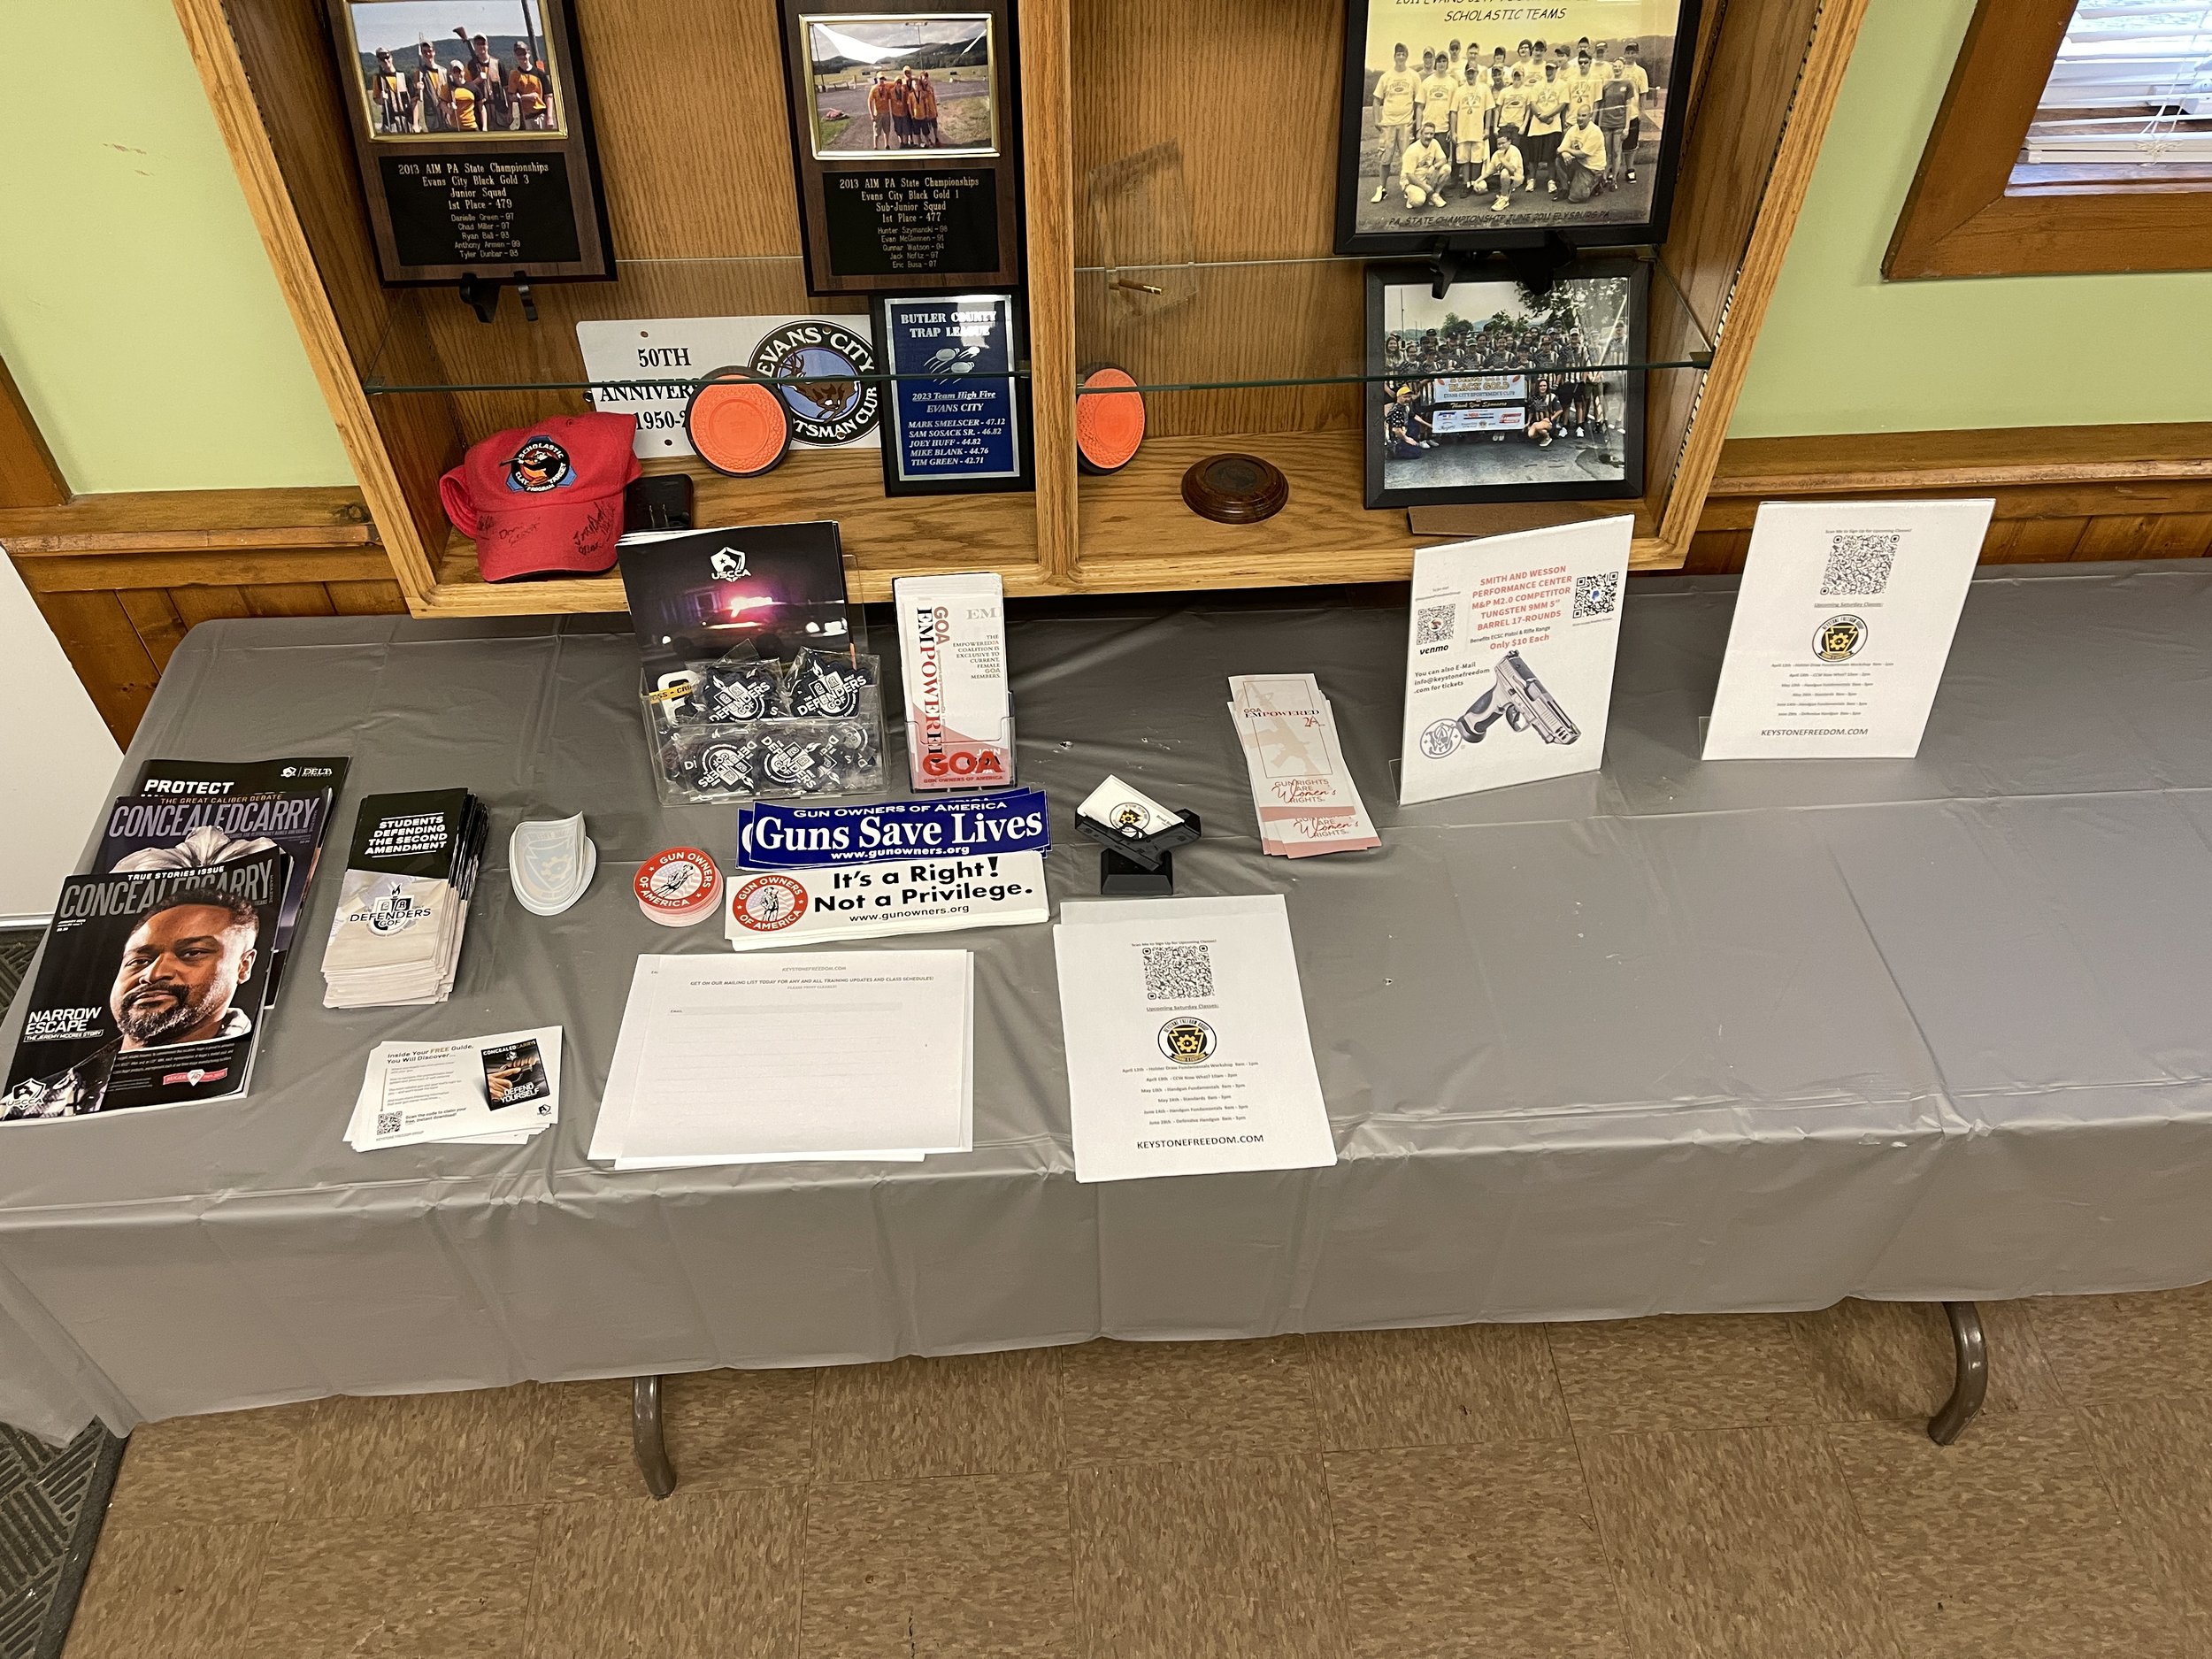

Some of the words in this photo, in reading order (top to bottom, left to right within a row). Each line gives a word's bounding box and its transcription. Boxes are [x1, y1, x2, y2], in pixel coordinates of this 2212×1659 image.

[1444, 10, 1522, 22] SCHOLASTIC
[1526, 8, 1567, 19] TEAMS
[399, 165, 419, 174] 2013
[426, 164, 441, 173] AIM
[447, 164, 458, 173] PA
[465, 163, 484, 173] State
[490, 162, 549, 174] Championships
[423, 177, 446, 187] Evans
[452, 176, 467, 187] City
[473, 175, 495, 185] Black
[501, 175, 518, 184] Gold
[524, 175, 529, 184] 3
[840, 180, 859, 188] 2013
[865, 179, 879, 188] AIM
[885, 179, 895, 188] PA
[902, 178, 919, 188] State
[925, 177, 979, 188] Championships
[450, 188, 476, 197] Junior
[482, 188, 506, 198] Squad
[862, 191, 883, 201] Evans
[888, 191, 903, 202] City
[909, 190, 928, 199] Black
[933, 189, 949, 199] Gold
[449, 201, 459, 210] 1st
[465, 200, 486, 209] Place
[495, 199, 512, 208] 479
[876, 202, 918, 211] Sub-Junior
[924, 202, 946, 211] Squad
[883, 214, 892, 223] 1st
[898, 213, 917, 222] Place
[926, 212, 941, 221] 477
[901, 313, 946, 324] BUTLER
[910, 328, 941, 338] TRAP
[638, 349, 691, 367] 50TH
[757, 327, 822, 377] EVANS
[830, 334, 875, 373] CITY
[958, 391, 978, 400] High
[793, 420, 852, 440] TSMAN
[518, 443, 564, 459] SCHOLASTIC
[516, 472, 529, 485] CLAY
[710, 569, 751, 580] USCCA
[1480, 576, 1507, 586] SMITH
[1509, 572, 1528, 581] AND
[1529, 565, 1567, 577] WESSON
[1472, 581, 1537, 598] PERFORMANCE
[1539, 576, 1572, 586] CENTER
[1471, 600, 1492, 610] M&P
[1494, 597, 1513, 606] M2.0
[1515, 587, 1571, 603] COMPETITOR
[1481, 607, 1527, 618] TUNGSTEN
[933, 606, 950, 646] GOA
[1478, 621, 1510, 631] BARREL
[1512, 611, 1562, 625] 17-ROUNDS
[1490, 640, 1509, 650] Only
[1512, 638, 1527, 647] $10
[1529, 634, 1550, 643] Each
[1419, 644, 1448, 655] venmo
[1455, 662, 1476, 671] E-Mail
[1414, 667, 1490, 686] info@keystonefreedom
[1442, 680, 1463, 689] tickets
[923, 751, 1005, 776] GOA
[144, 780, 234, 795] PROTECT
[794, 809, 830, 818] GUN
[833, 805, 906, 816] OWNERS
[933, 802, 1008, 812] AMERICA
[379, 816, 443, 828] STUDENTS
[373, 825, 446, 838] DEFENDING
[756, 816, 849, 850] Guns
[859, 816, 942, 846] Save
[951, 811, 1043, 844] Lives
[396, 833, 448, 844] SECOND
[365, 841, 447, 855] AMENDMENT
[831, 846, 970, 860] www.gunowners.org
[155, 870, 195, 879] STORIES
[198, 866, 225, 875] ISSUE
[659, 852, 685, 864] GUN
[687, 852, 713, 888] OWNERS
[833, 871, 872, 889] It's
[882, 872, 899, 885] a
[910, 856, 999, 886] Right!
[640, 876, 649, 887] OF
[738, 883, 758, 900] GUN
[759, 878, 803, 895] OWNERS
[641, 889, 689, 907] AMERICA
[815, 895, 865, 912] Not
[875, 893, 891, 906] a
[902, 883, 1033, 905] Privilege.
[350, 908, 431, 922] DEFENDERS
[740, 914, 752, 925] OF
[754, 910, 803, 930] AMERICA
[849, 904, 970, 922] www.gunowners.org
[28, 1007, 102, 1023] NARROW
[25, 1020, 87, 1034] ESCAPE
[500, 1087, 540, 1103] YOURSELF
[503, 1082, 534, 1097] DEFEND
[1137, 1135, 1263, 1149] KEYSTONEFREEDOM.COM
